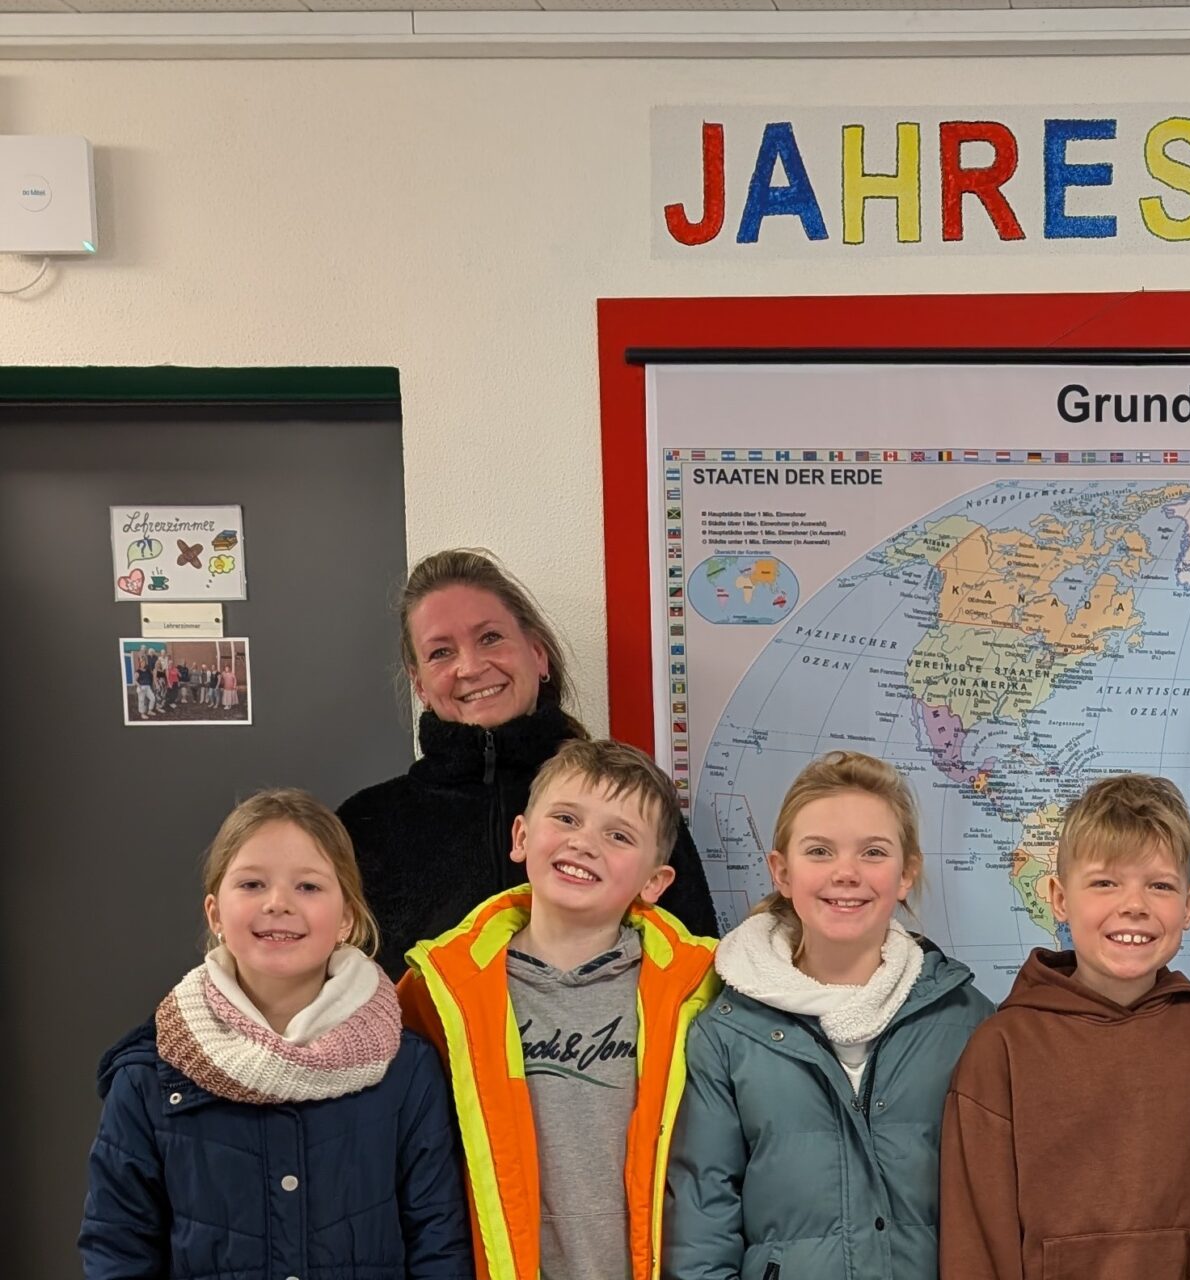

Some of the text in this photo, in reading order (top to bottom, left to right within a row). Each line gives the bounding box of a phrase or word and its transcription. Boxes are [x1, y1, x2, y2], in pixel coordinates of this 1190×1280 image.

[693, 468, 882, 485] STAATEN DER ERDE
[966, 486, 1075, 509] Nordpolarmeer
[122, 511, 215, 539] Lehrerzimmer
[708, 520, 726, 528] Städte
[727, 520, 741, 528] über
[760, 520, 790, 528] Einwohner
[800, 520, 827, 528] Auswahl)
[708, 529, 742, 537] Hauptstädte
[744, 529, 759, 537] unter
[778, 529, 808, 537] Einwohner
[819, 529, 846, 537] Auswahl)
[708, 538, 726, 546] Städte
[727, 538, 743, 546] unter
[762, 538, 792, 546] Einwohner
[803, 538, 830, 546] Auswahl)
[923, 538, 950, 549] Alaska
[952, 585, 1125, 612] KANADA
[795, 626, 898, 650] PAZIFISCHER
[801, 655, 852, 671] OZEAN
[906, 659, 1050, 678] VEREINIGTE STAATEN
[944, 677, 1027, 690] VON AMERIKA
[953, 688, 984, 698] (USA)
[1130, 707, 1179, 717] OZEAN
[1024, 882, 1044, 914] PERU
[560, 1032, 582, 1062] &
